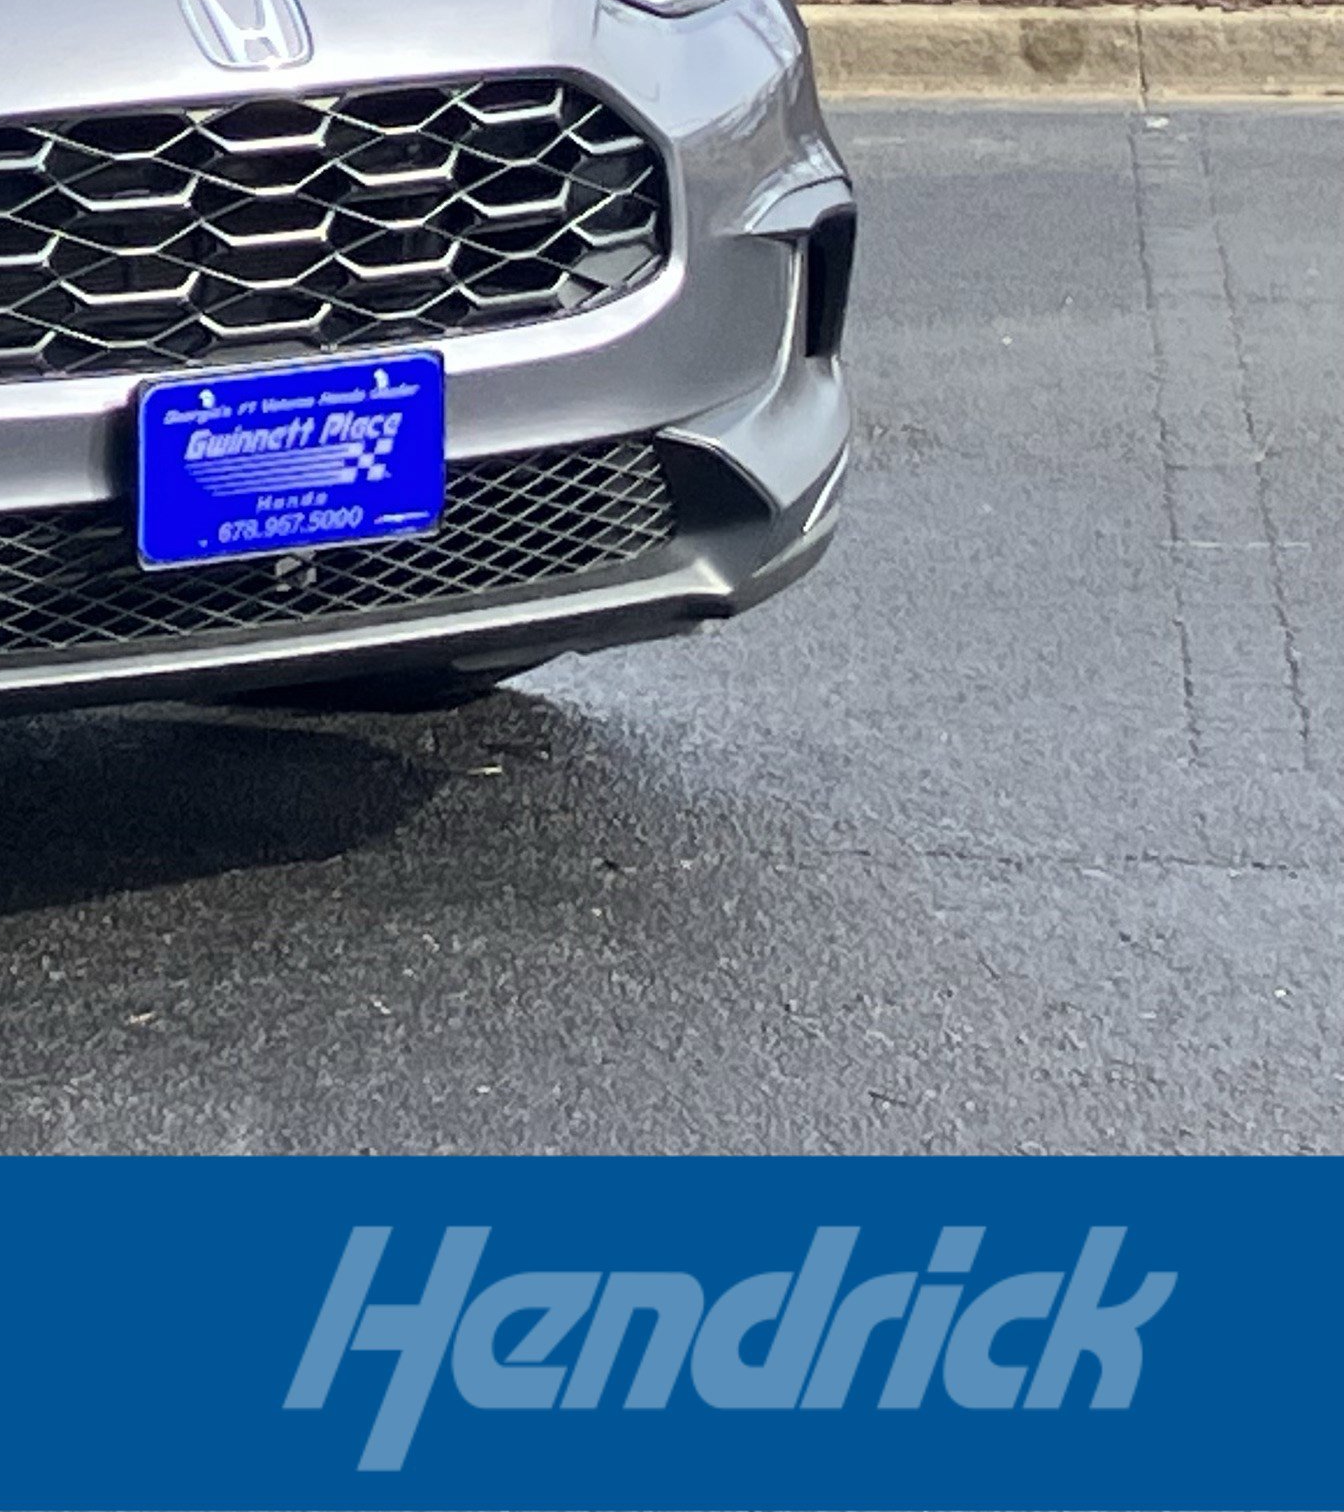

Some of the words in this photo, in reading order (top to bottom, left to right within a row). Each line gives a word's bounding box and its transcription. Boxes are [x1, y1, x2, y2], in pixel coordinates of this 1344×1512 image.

[184, 417, 315, 461] Gwinnett
[319, 410, 403, 445] Place
[256, 491, 329, 513] Honda
